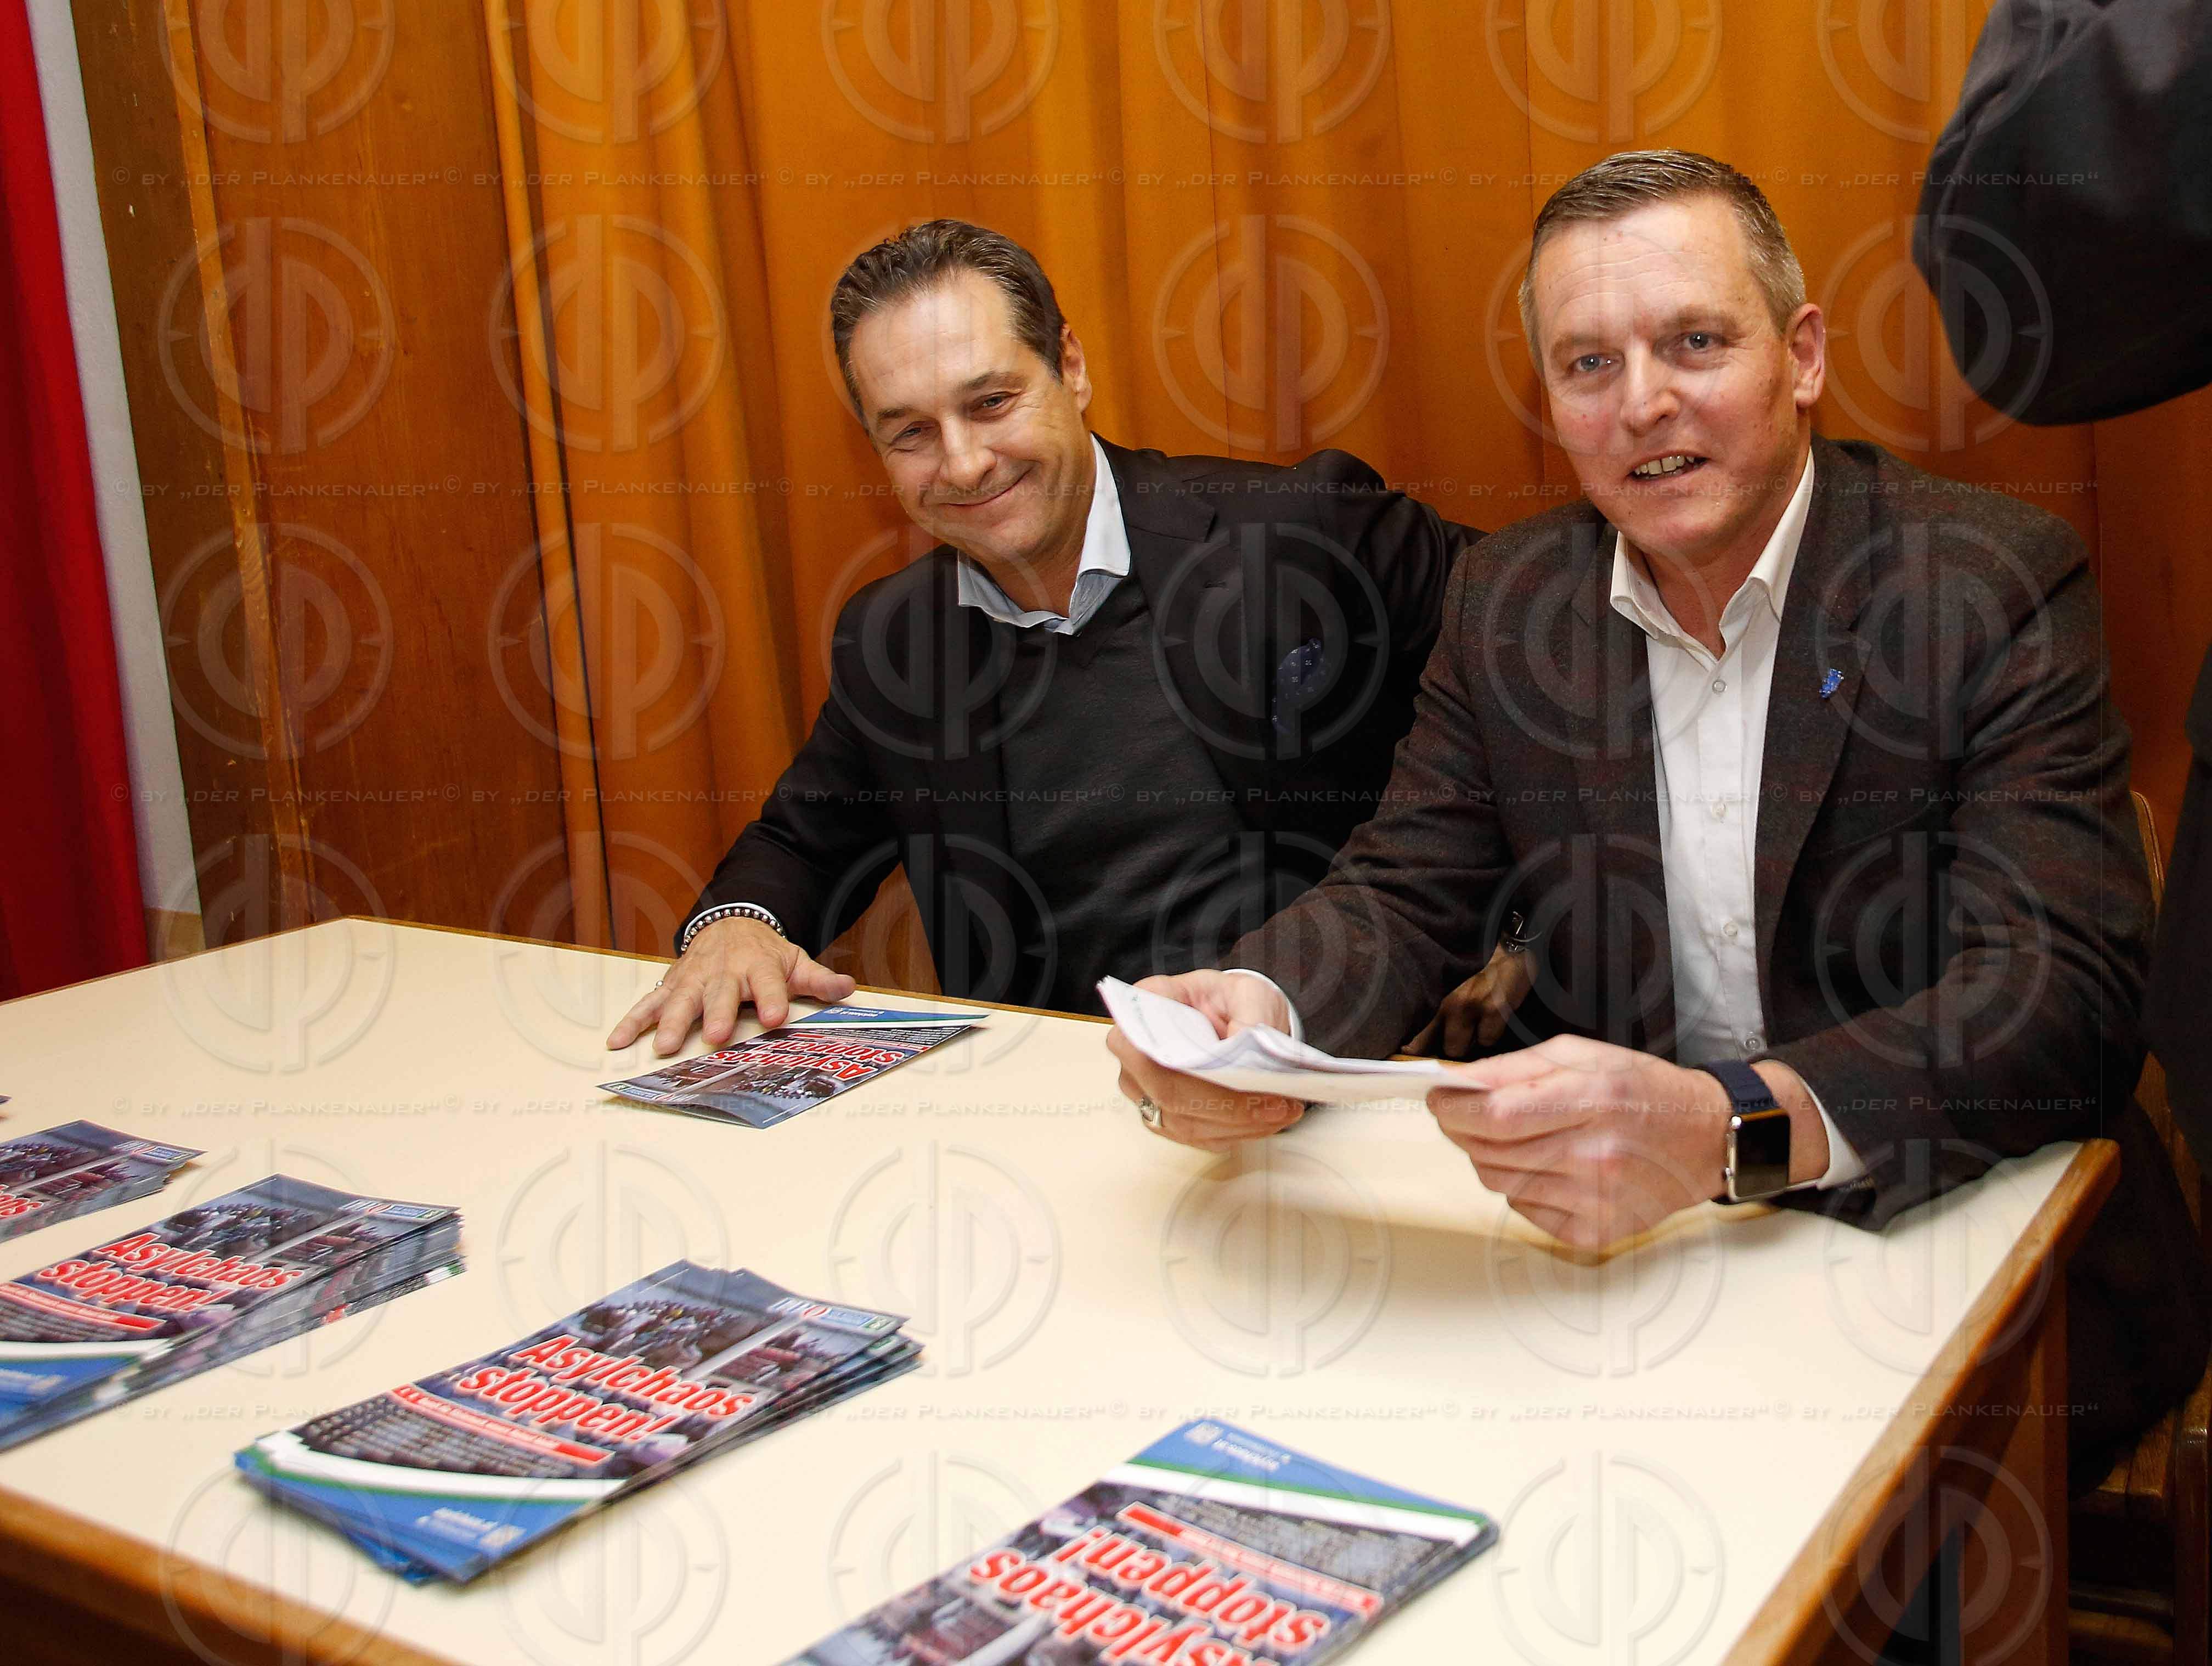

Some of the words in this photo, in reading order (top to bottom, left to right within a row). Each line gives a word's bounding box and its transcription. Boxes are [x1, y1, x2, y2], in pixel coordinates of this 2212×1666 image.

[706, 1050, 878, 1080] Asylchaos
[38, 1259, 237, 1312] stoppen!
[93, 1232, 305, 1290] Asylchaos
[457, 1366, 674, 1441] stoppen!
[508, 1333, 757, 1417] Asylchaos
[969, 1547, 1280, 1665] sylchaos
[1053, 1527, 1330, 1651] stoppen!
